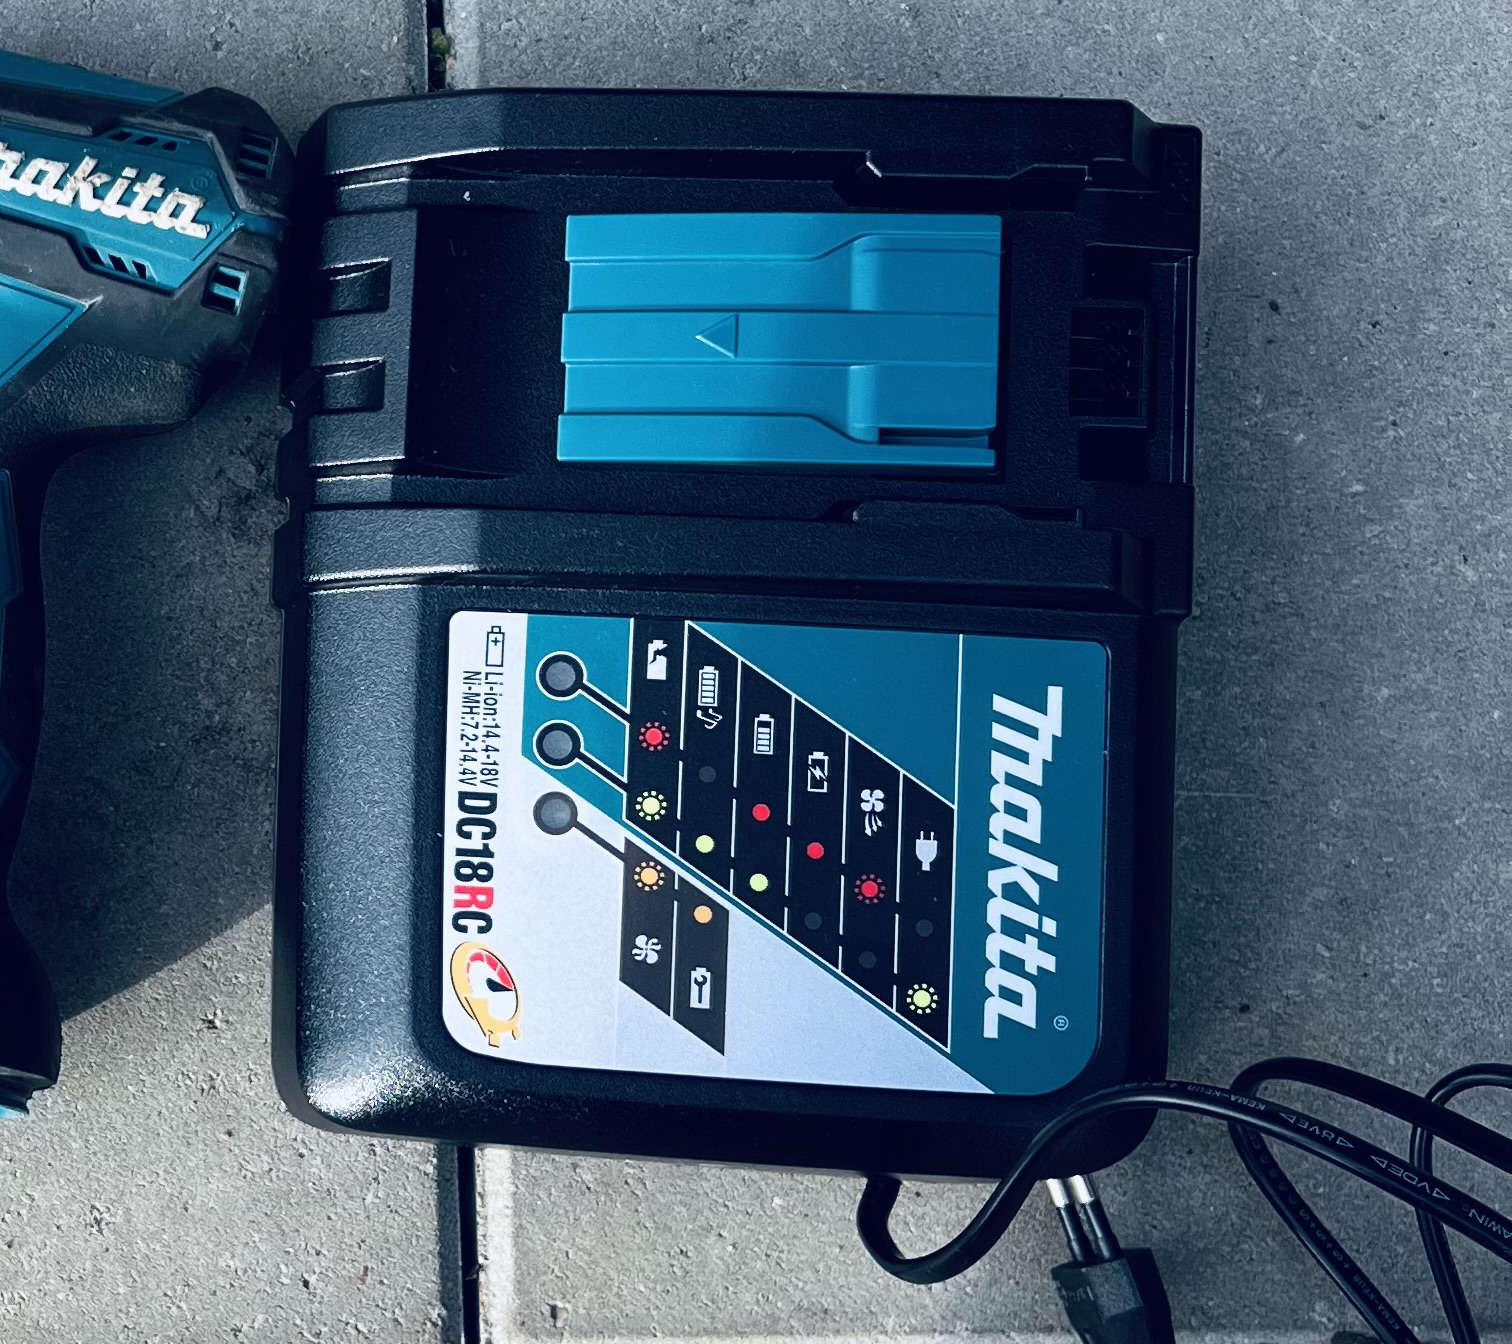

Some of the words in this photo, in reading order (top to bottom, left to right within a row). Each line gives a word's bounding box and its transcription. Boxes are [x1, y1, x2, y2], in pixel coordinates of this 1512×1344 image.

[457, 670, 483, 787] Ni-MH:7.2-14.4V
[480, 672, 504, 788] Li-ion:14.4-18V
[451, 790, 498, 935] DC18RC
